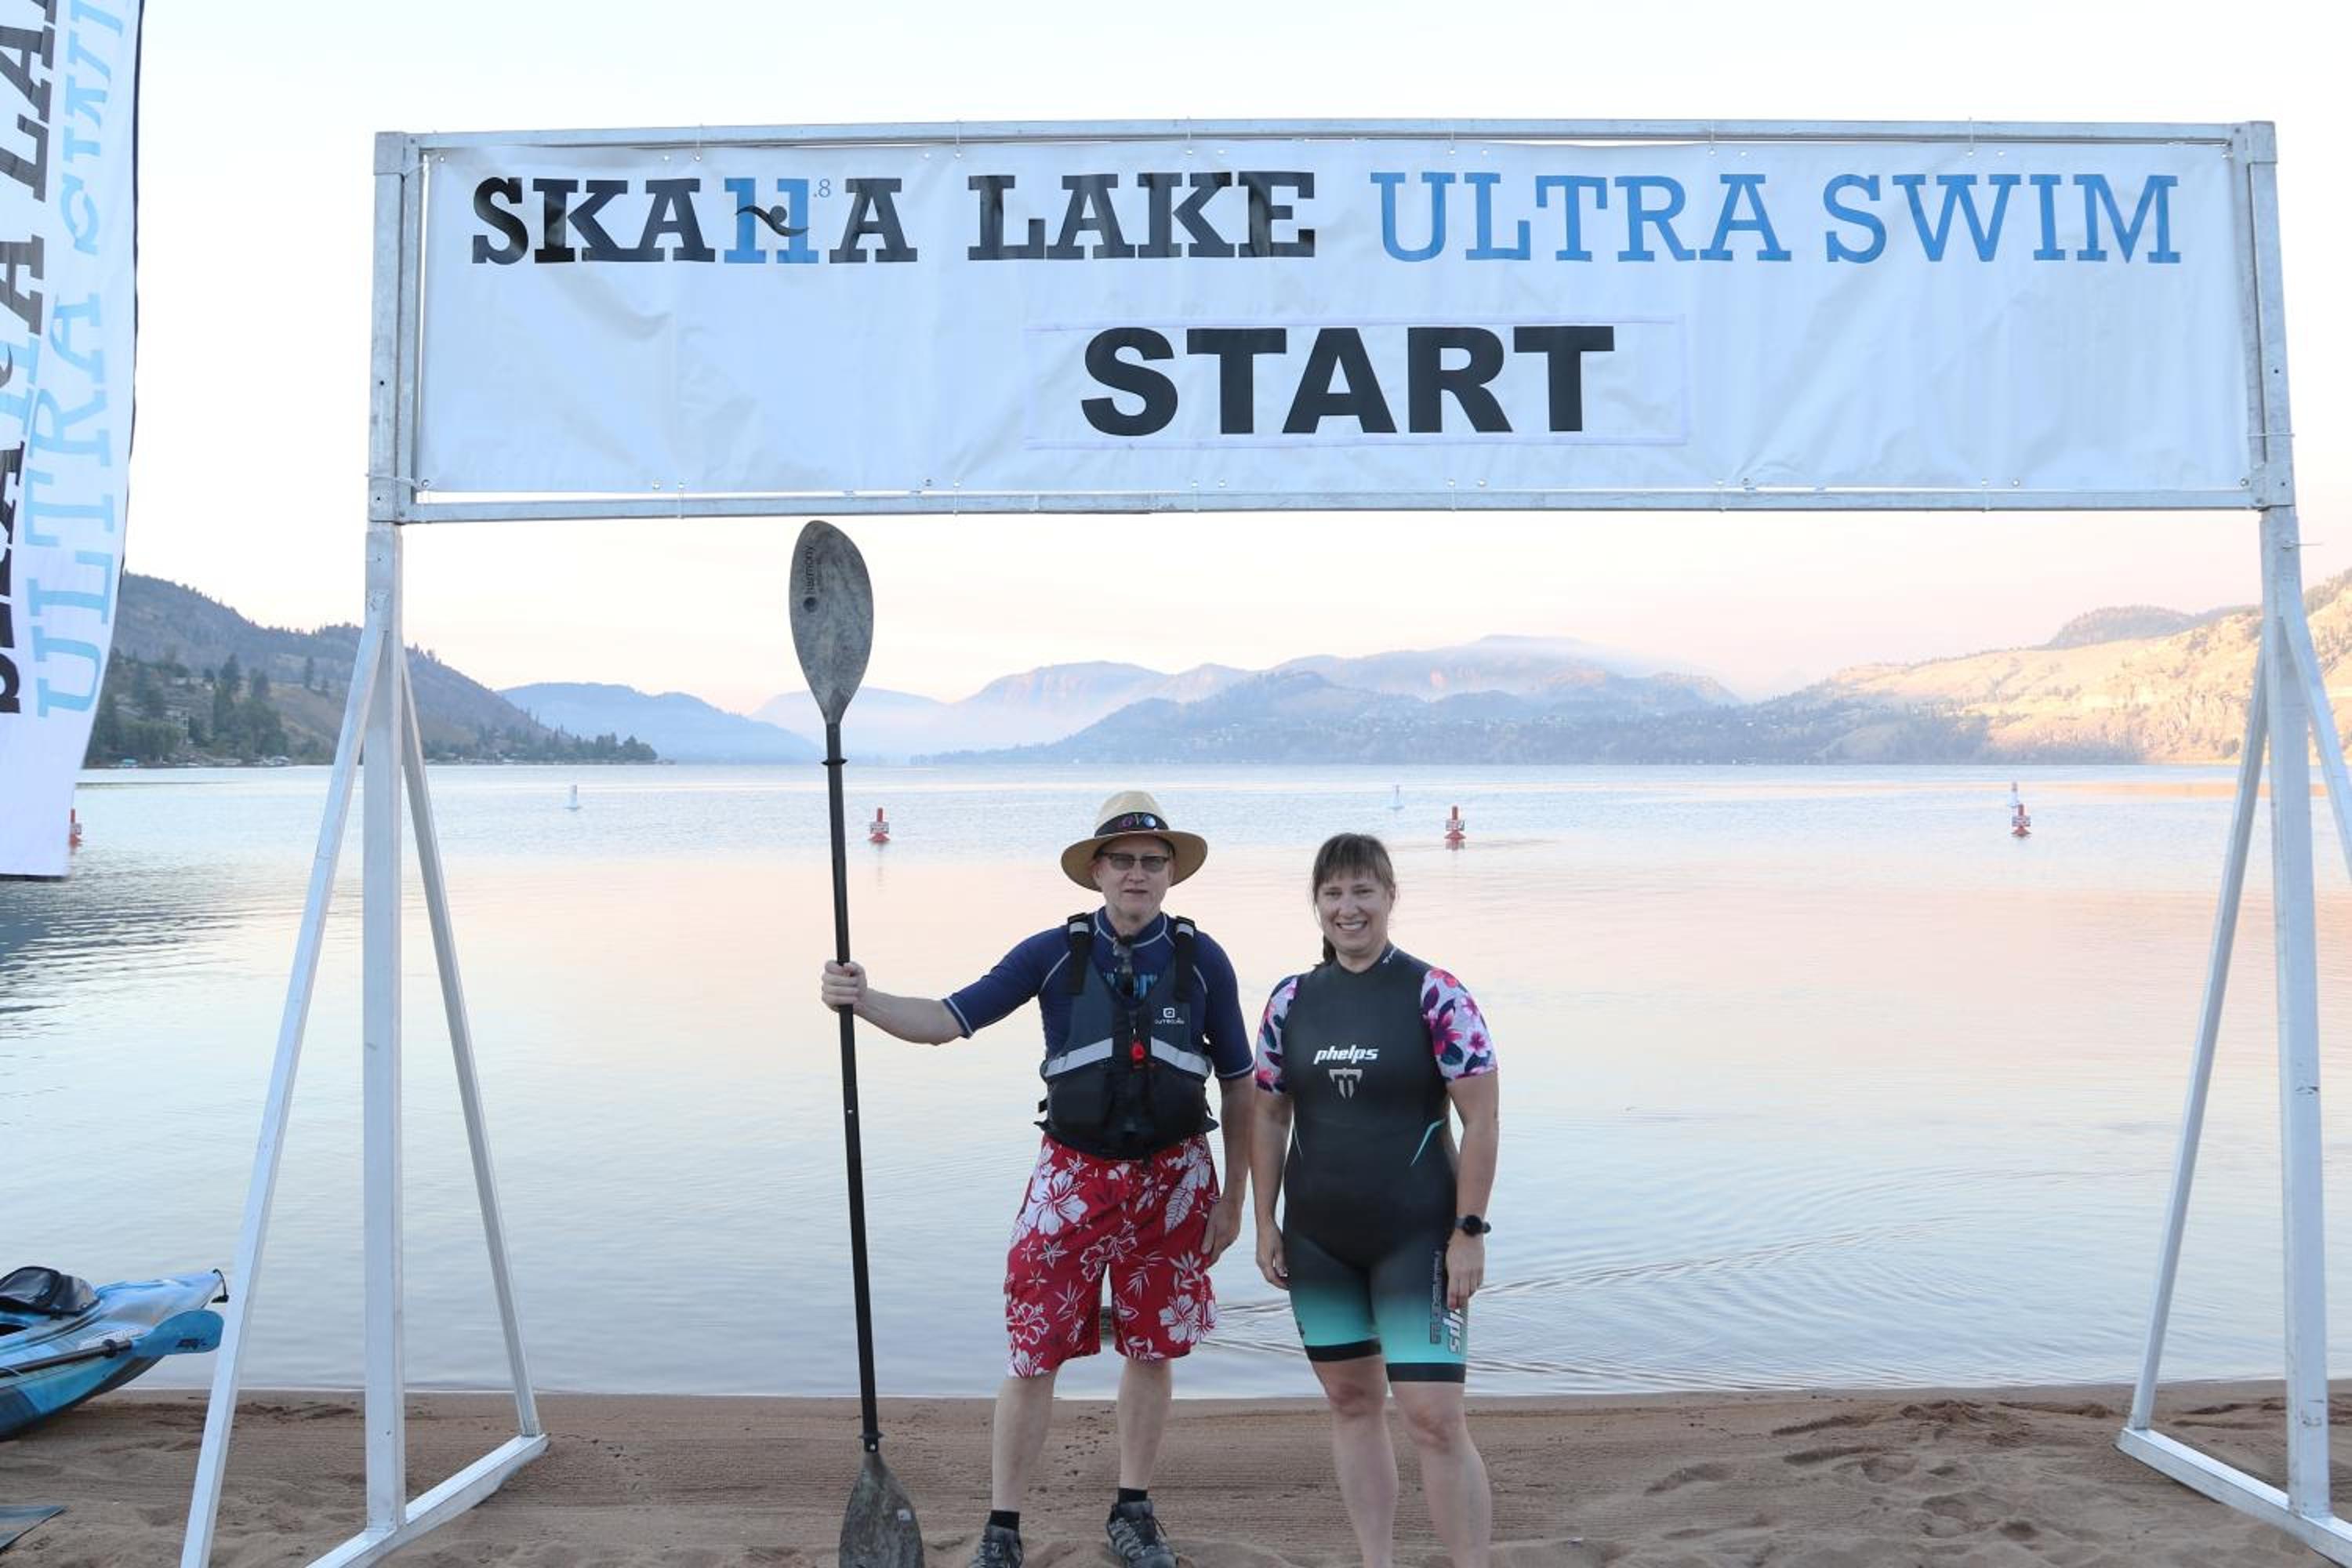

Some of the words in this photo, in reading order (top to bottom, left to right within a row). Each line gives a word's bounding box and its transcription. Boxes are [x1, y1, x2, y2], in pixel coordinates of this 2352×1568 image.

[968, 172, 1316, 260] LAKE
[1370, 172, 1792, 262] ULTRA
[1823, 174, 2182, 263] SWIM
[1081, 326, 1615, 437] START
[1313, 1044, 1379, 1065] phelps
